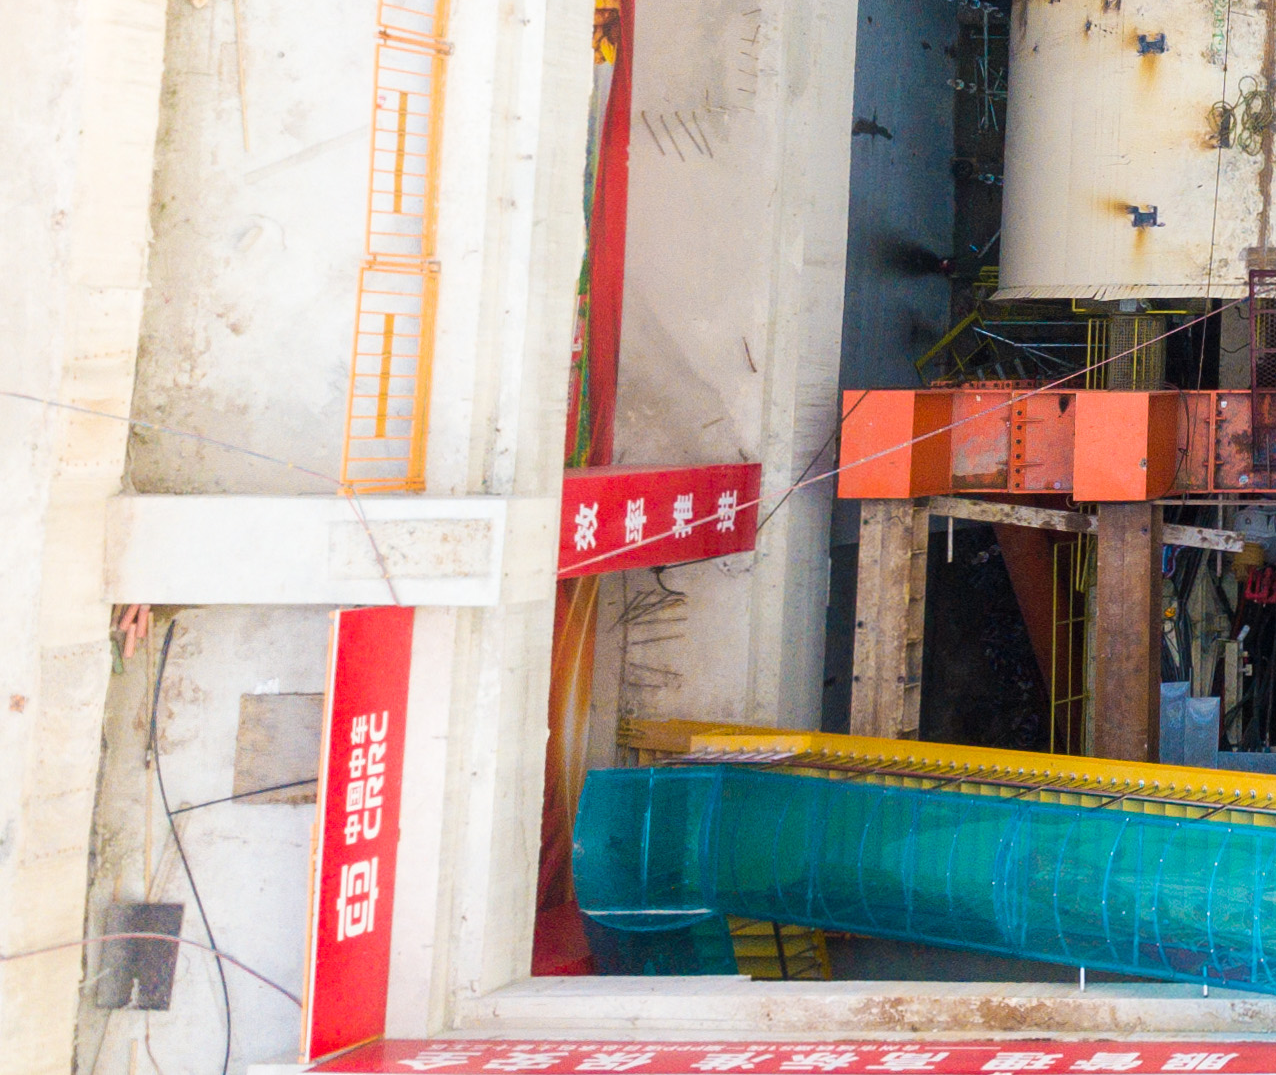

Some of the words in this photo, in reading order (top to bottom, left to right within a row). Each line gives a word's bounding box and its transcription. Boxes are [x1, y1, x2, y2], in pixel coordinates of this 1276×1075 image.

[574, 490, 738, 551] 效率推进
[344, 715, 368, 845] 中国中车
[363, 711, 389, 840] CRRC
